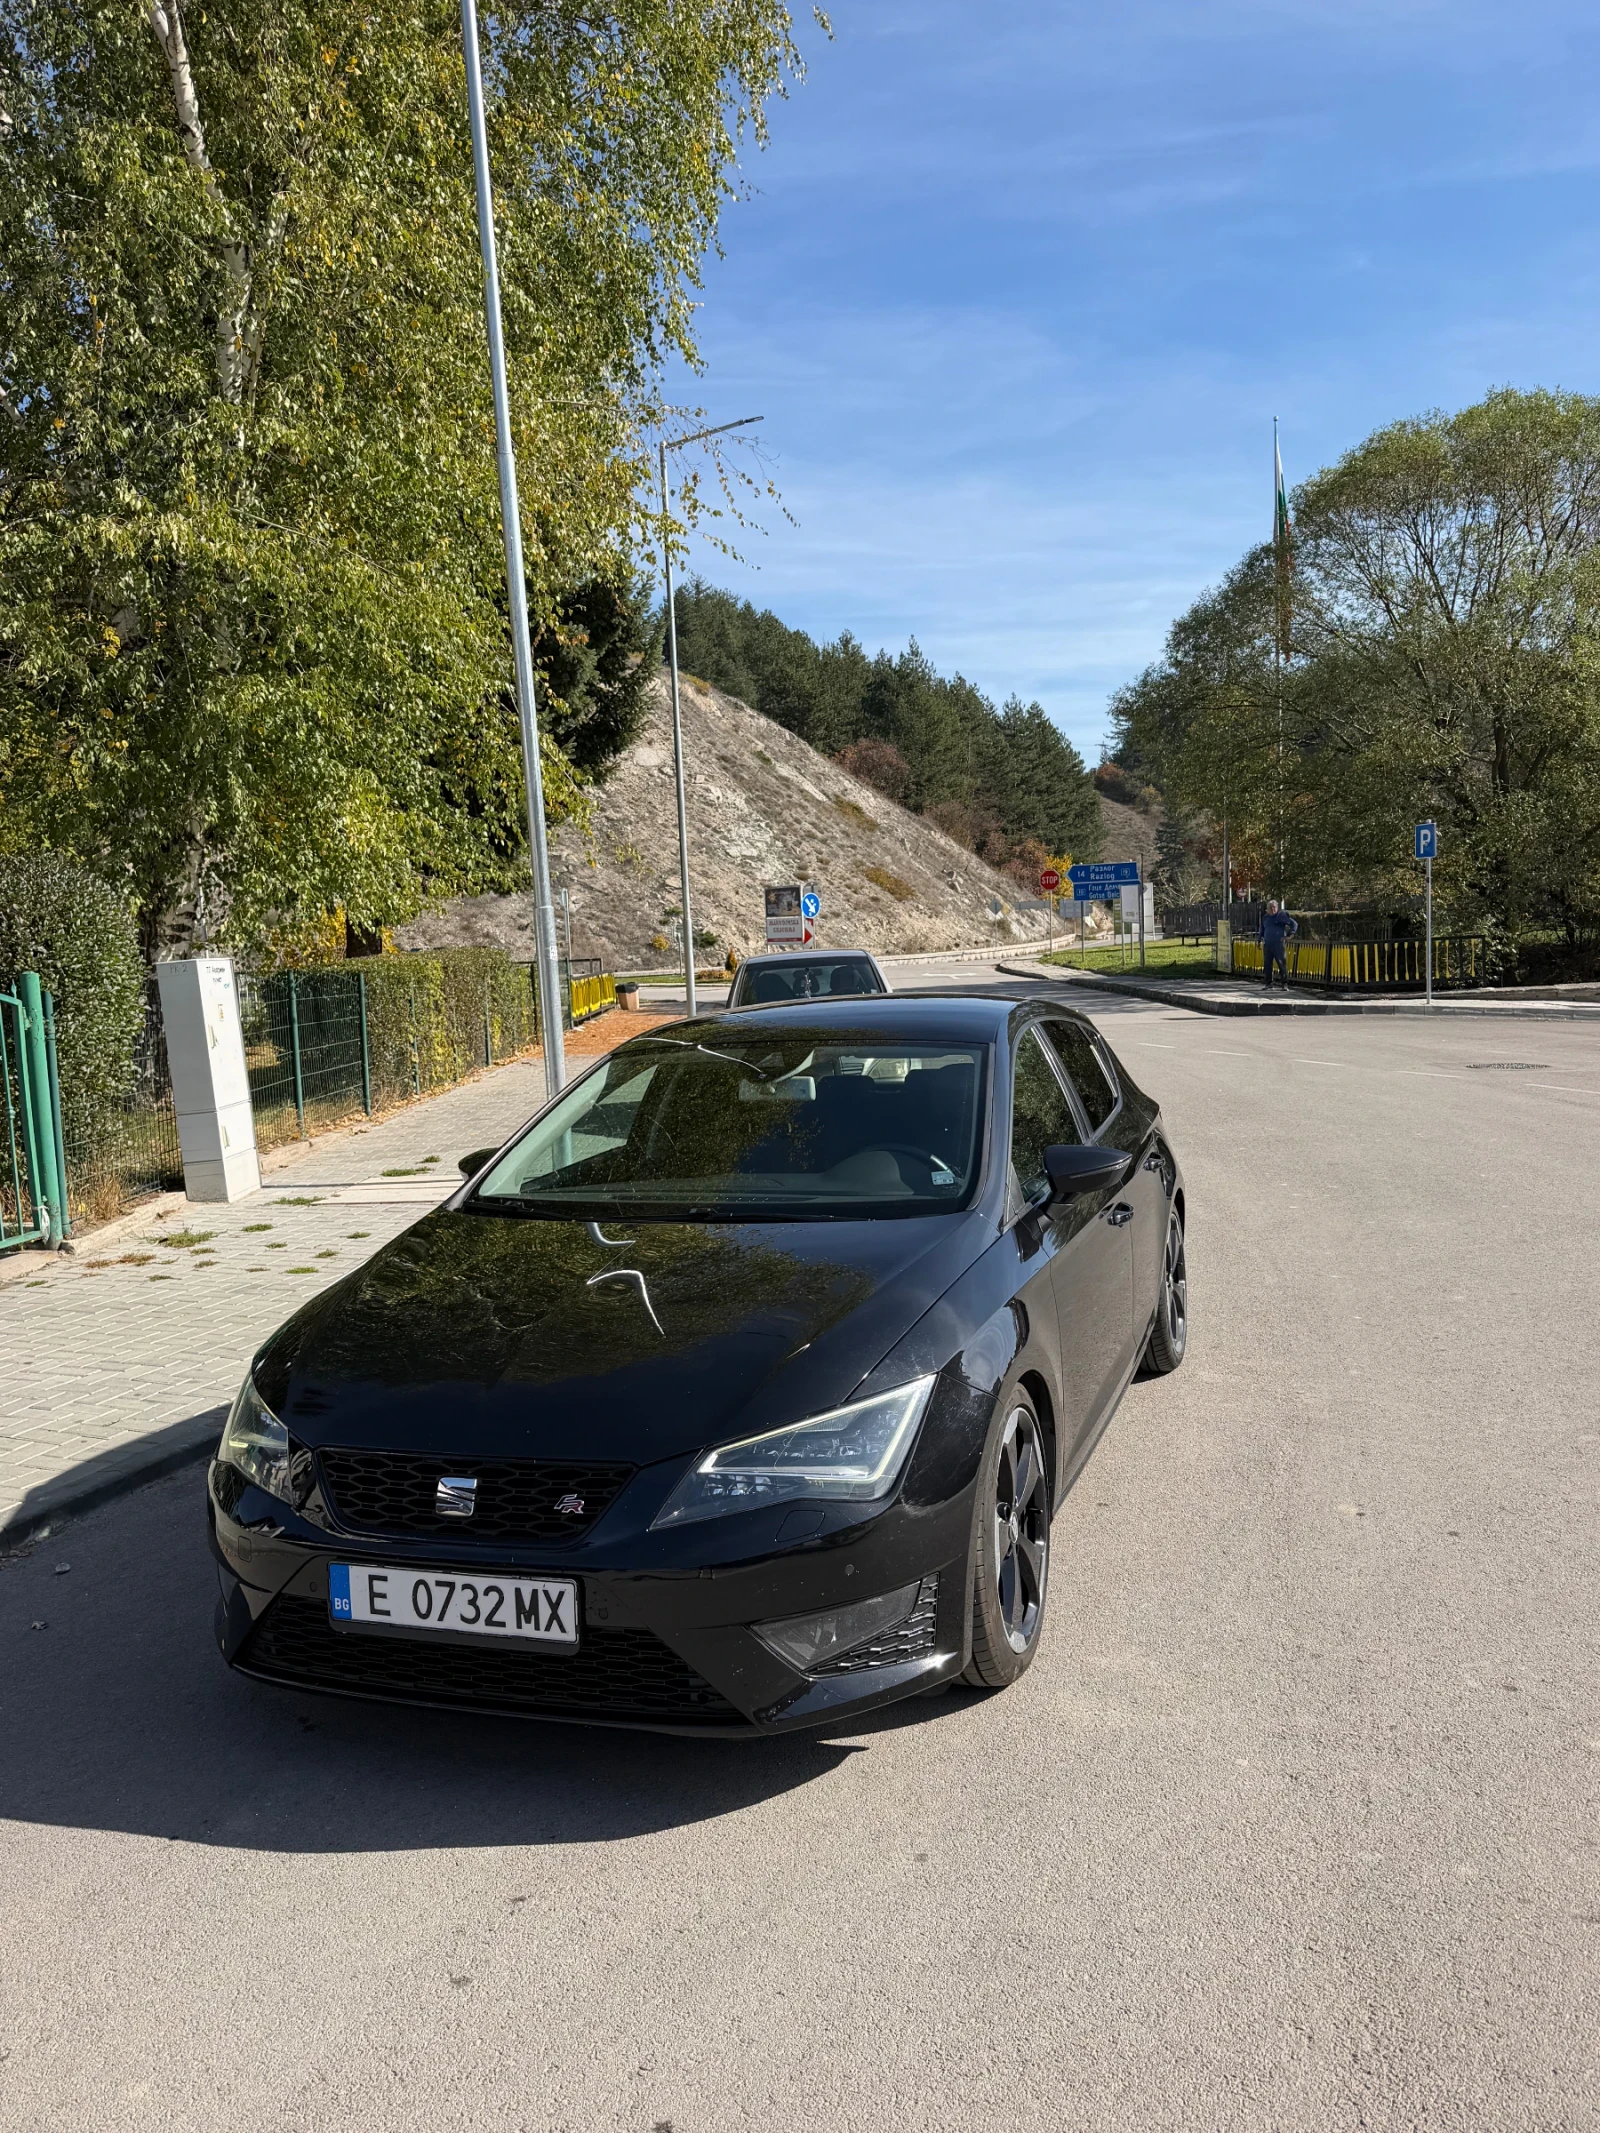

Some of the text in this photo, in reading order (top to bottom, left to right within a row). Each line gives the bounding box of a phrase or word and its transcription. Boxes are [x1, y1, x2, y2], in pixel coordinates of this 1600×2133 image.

[1420, 829, 1431, 854] P
[1041, 875, 1058, 885] STOP
[1107, 891, 1120, 899] Delc
[553, 1493, 585, 1514] FR
[334, 1597, 350, 1611] BG
[367, 1574, 391, 1617] E
